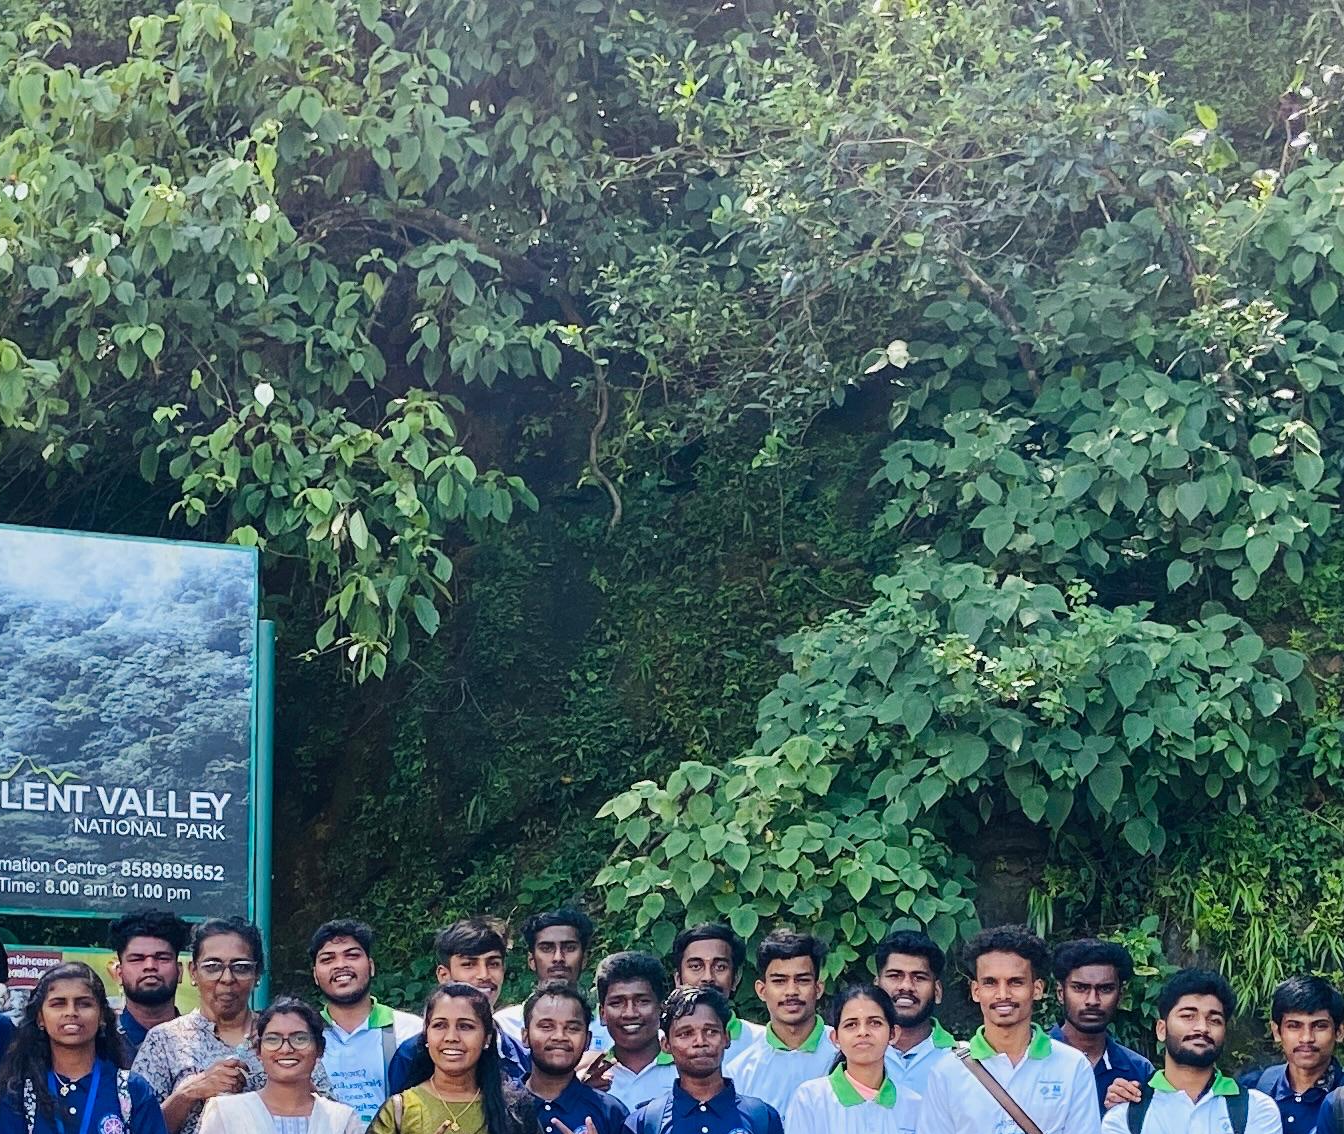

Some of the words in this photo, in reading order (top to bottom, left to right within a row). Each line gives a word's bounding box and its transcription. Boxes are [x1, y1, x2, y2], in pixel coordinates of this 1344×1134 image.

[96, 786, 232, 821] VALLEY
[74, 818, 167, 838] NATIONAL
[176, 823, 226, 840] PARK
[56, 859, 107, 876] Centre
[121, 862, 225, 881] 8589895652
[45, 880, 79, 895] 8.00
[84, 884, 107, 897] am
[112, 884, 127, 897] to
[131, 884, 163, 899] 1.00
[168, 889, 191, 902] pm
